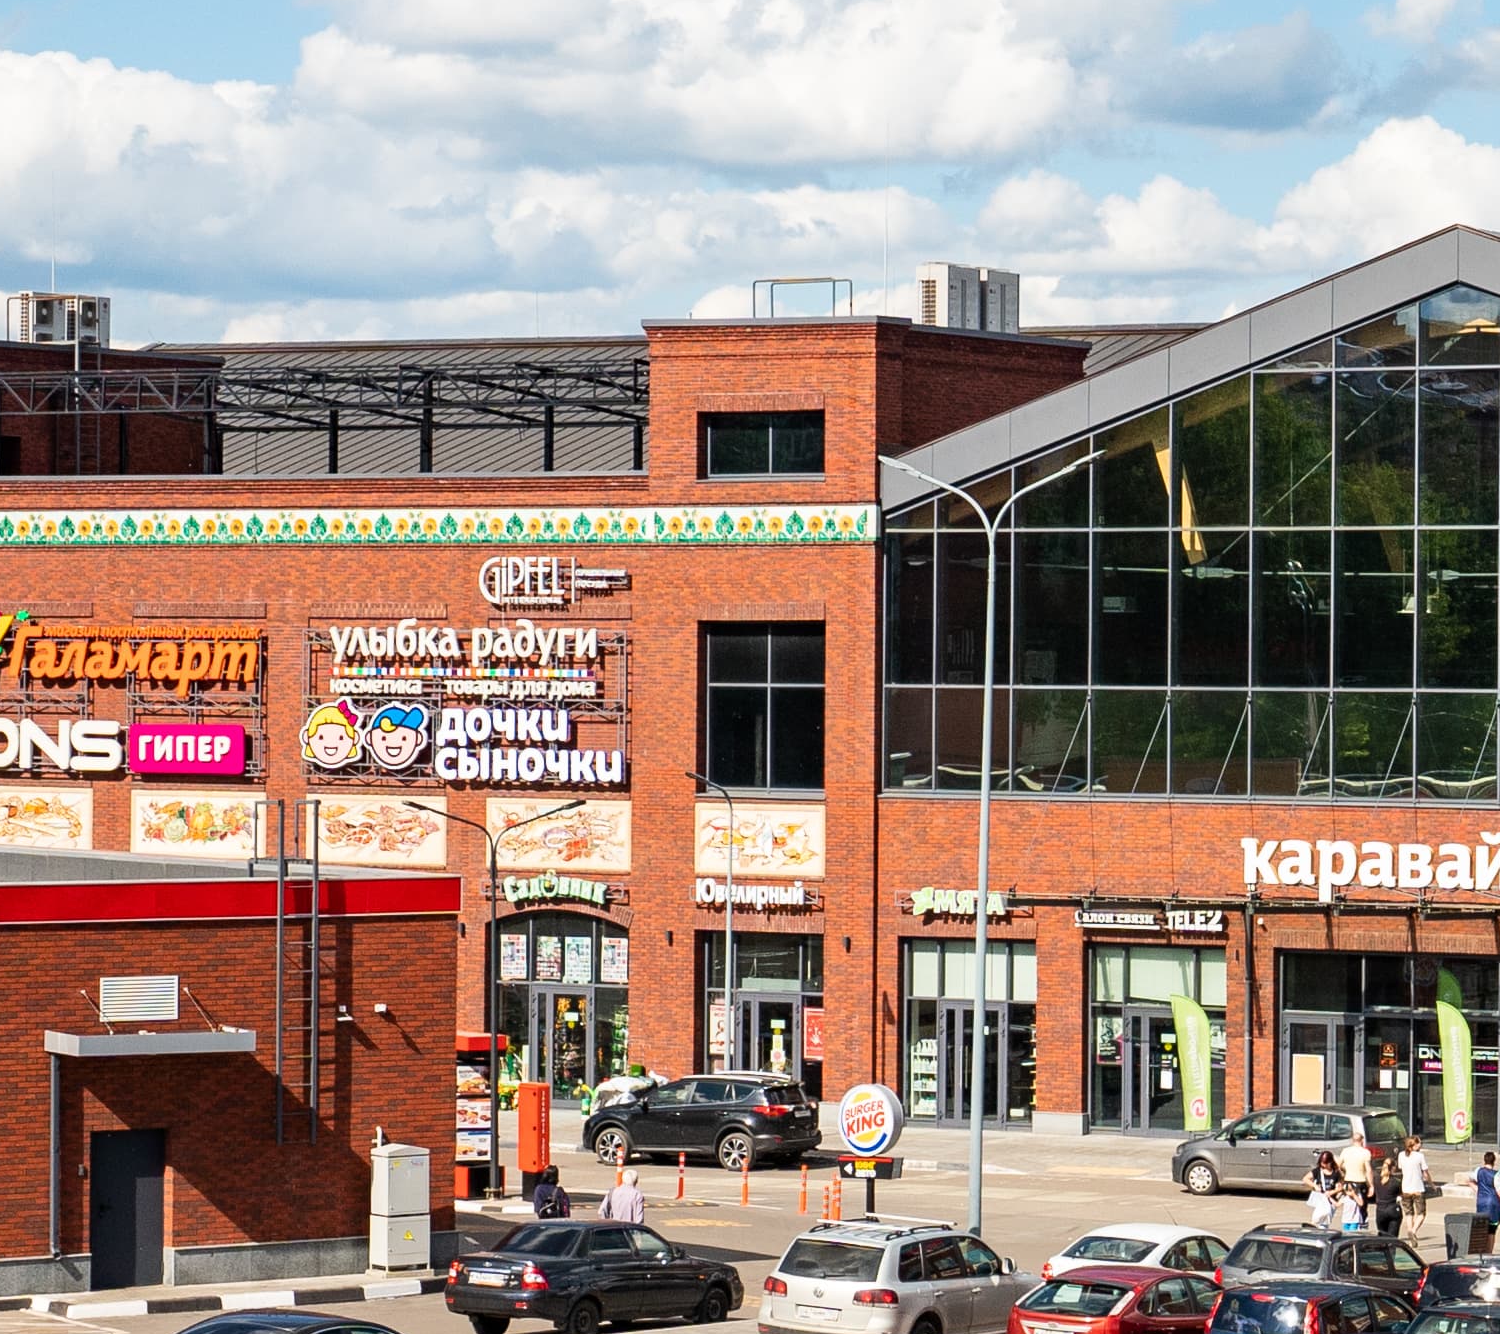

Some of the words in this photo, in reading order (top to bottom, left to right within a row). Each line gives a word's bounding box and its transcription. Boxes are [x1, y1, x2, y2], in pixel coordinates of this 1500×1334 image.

[44, 626, 100, 638] магазин
[101, 626, 185, 639] постоянных
[186, 625, 262, 642] распродаж
[329, 618, 462, 663] улыбка
[471, 618, 597, 666] радуги
[6, 622, 259, 697] Галамарт
[329, 678, 422, 695] косметика
[443, 679, 508, 700] товары
[509, 681, 547, 700] для
[549, 681, 596, 701] дома
[437, 708, 569, 746] дочки
[138, 735, 232, 762] ГИПЕР
[435, 747, 623, 782] сыночки
[695, 877, 805, 911] Ювелирный
[1166, 911, 1223, 931] TELE2
[1419, 1048, 1441, 1059] DN
[845, 1100, 884, 1121] BURGER
[846, 1112, 885, 1138] KING
